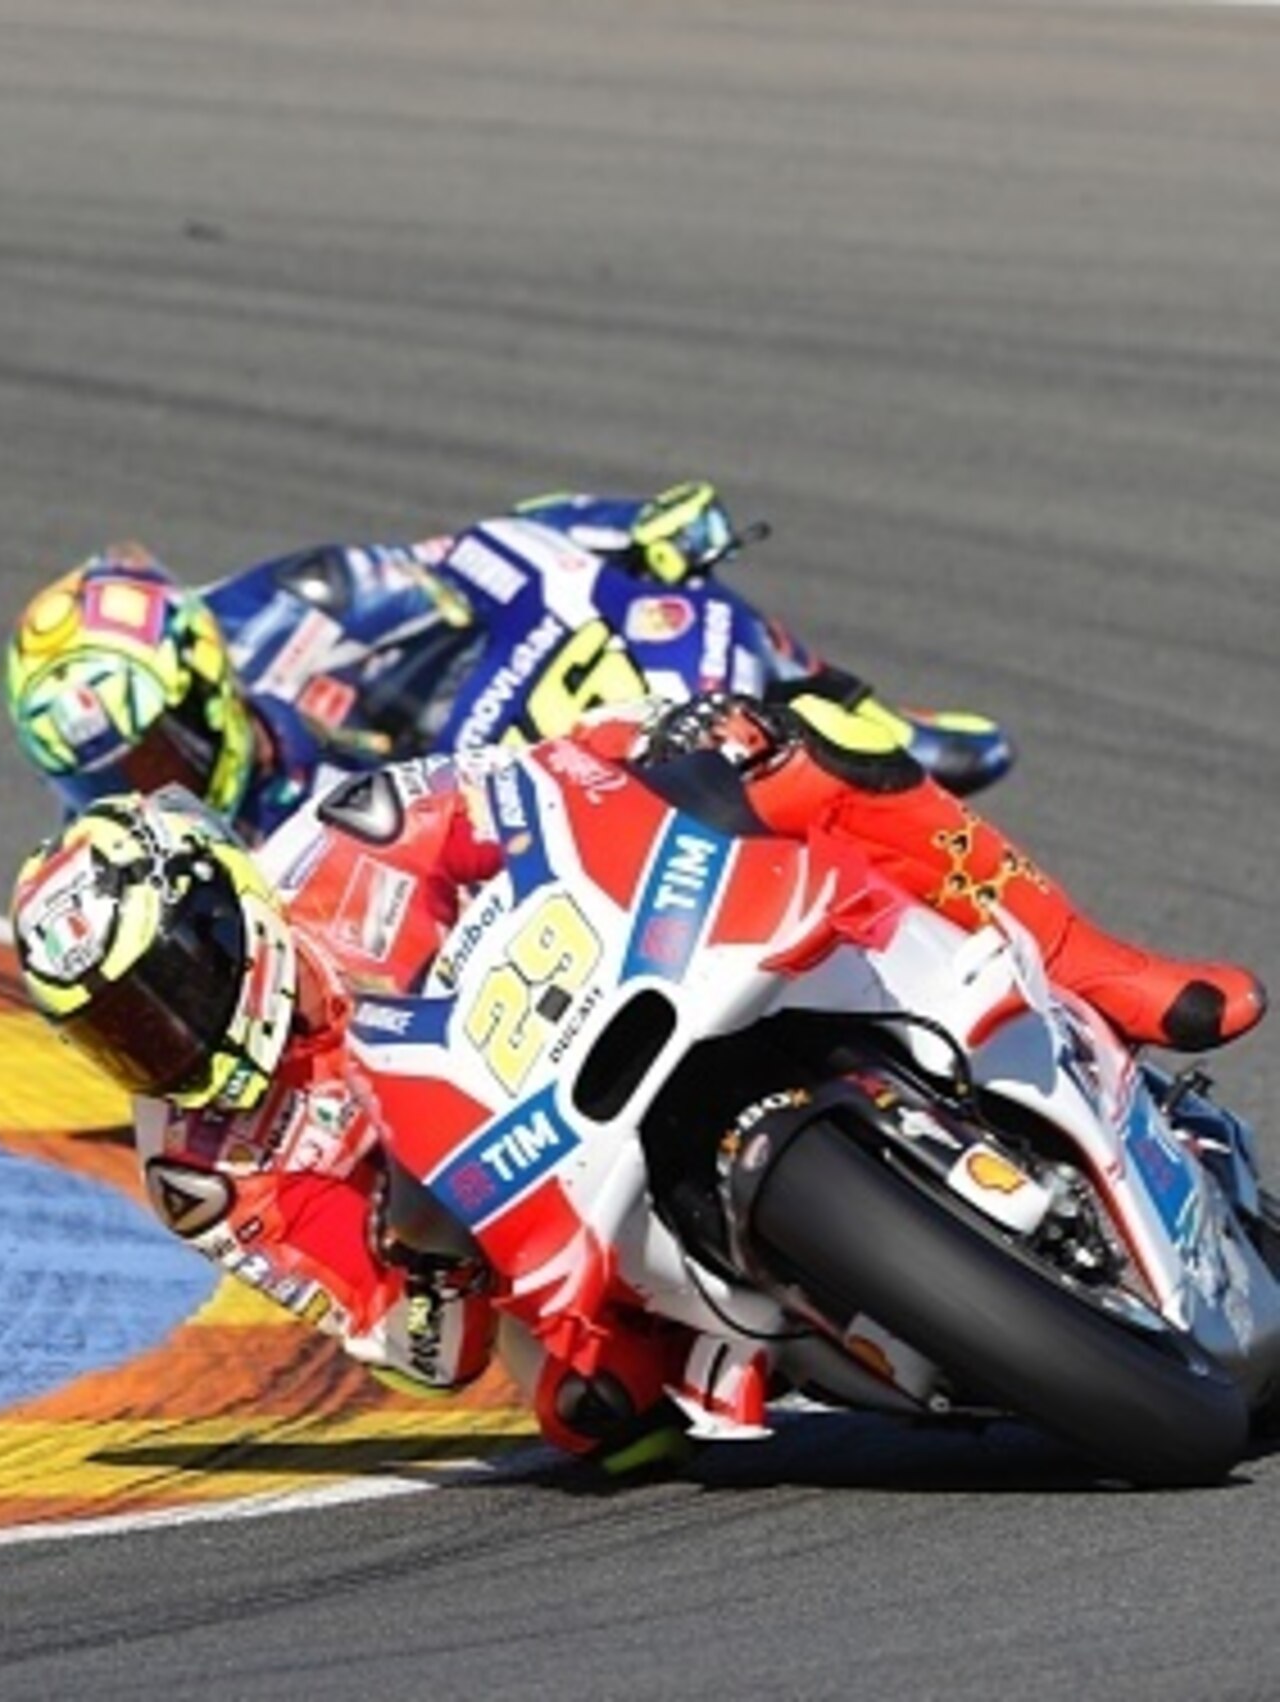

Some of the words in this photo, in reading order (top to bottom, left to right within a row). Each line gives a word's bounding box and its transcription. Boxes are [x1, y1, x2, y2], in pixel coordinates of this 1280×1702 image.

[653, 833, 718, 910] TIM
[463, 891, 604, 1098] 29
[479, 1109, 561, 1182] TIM
